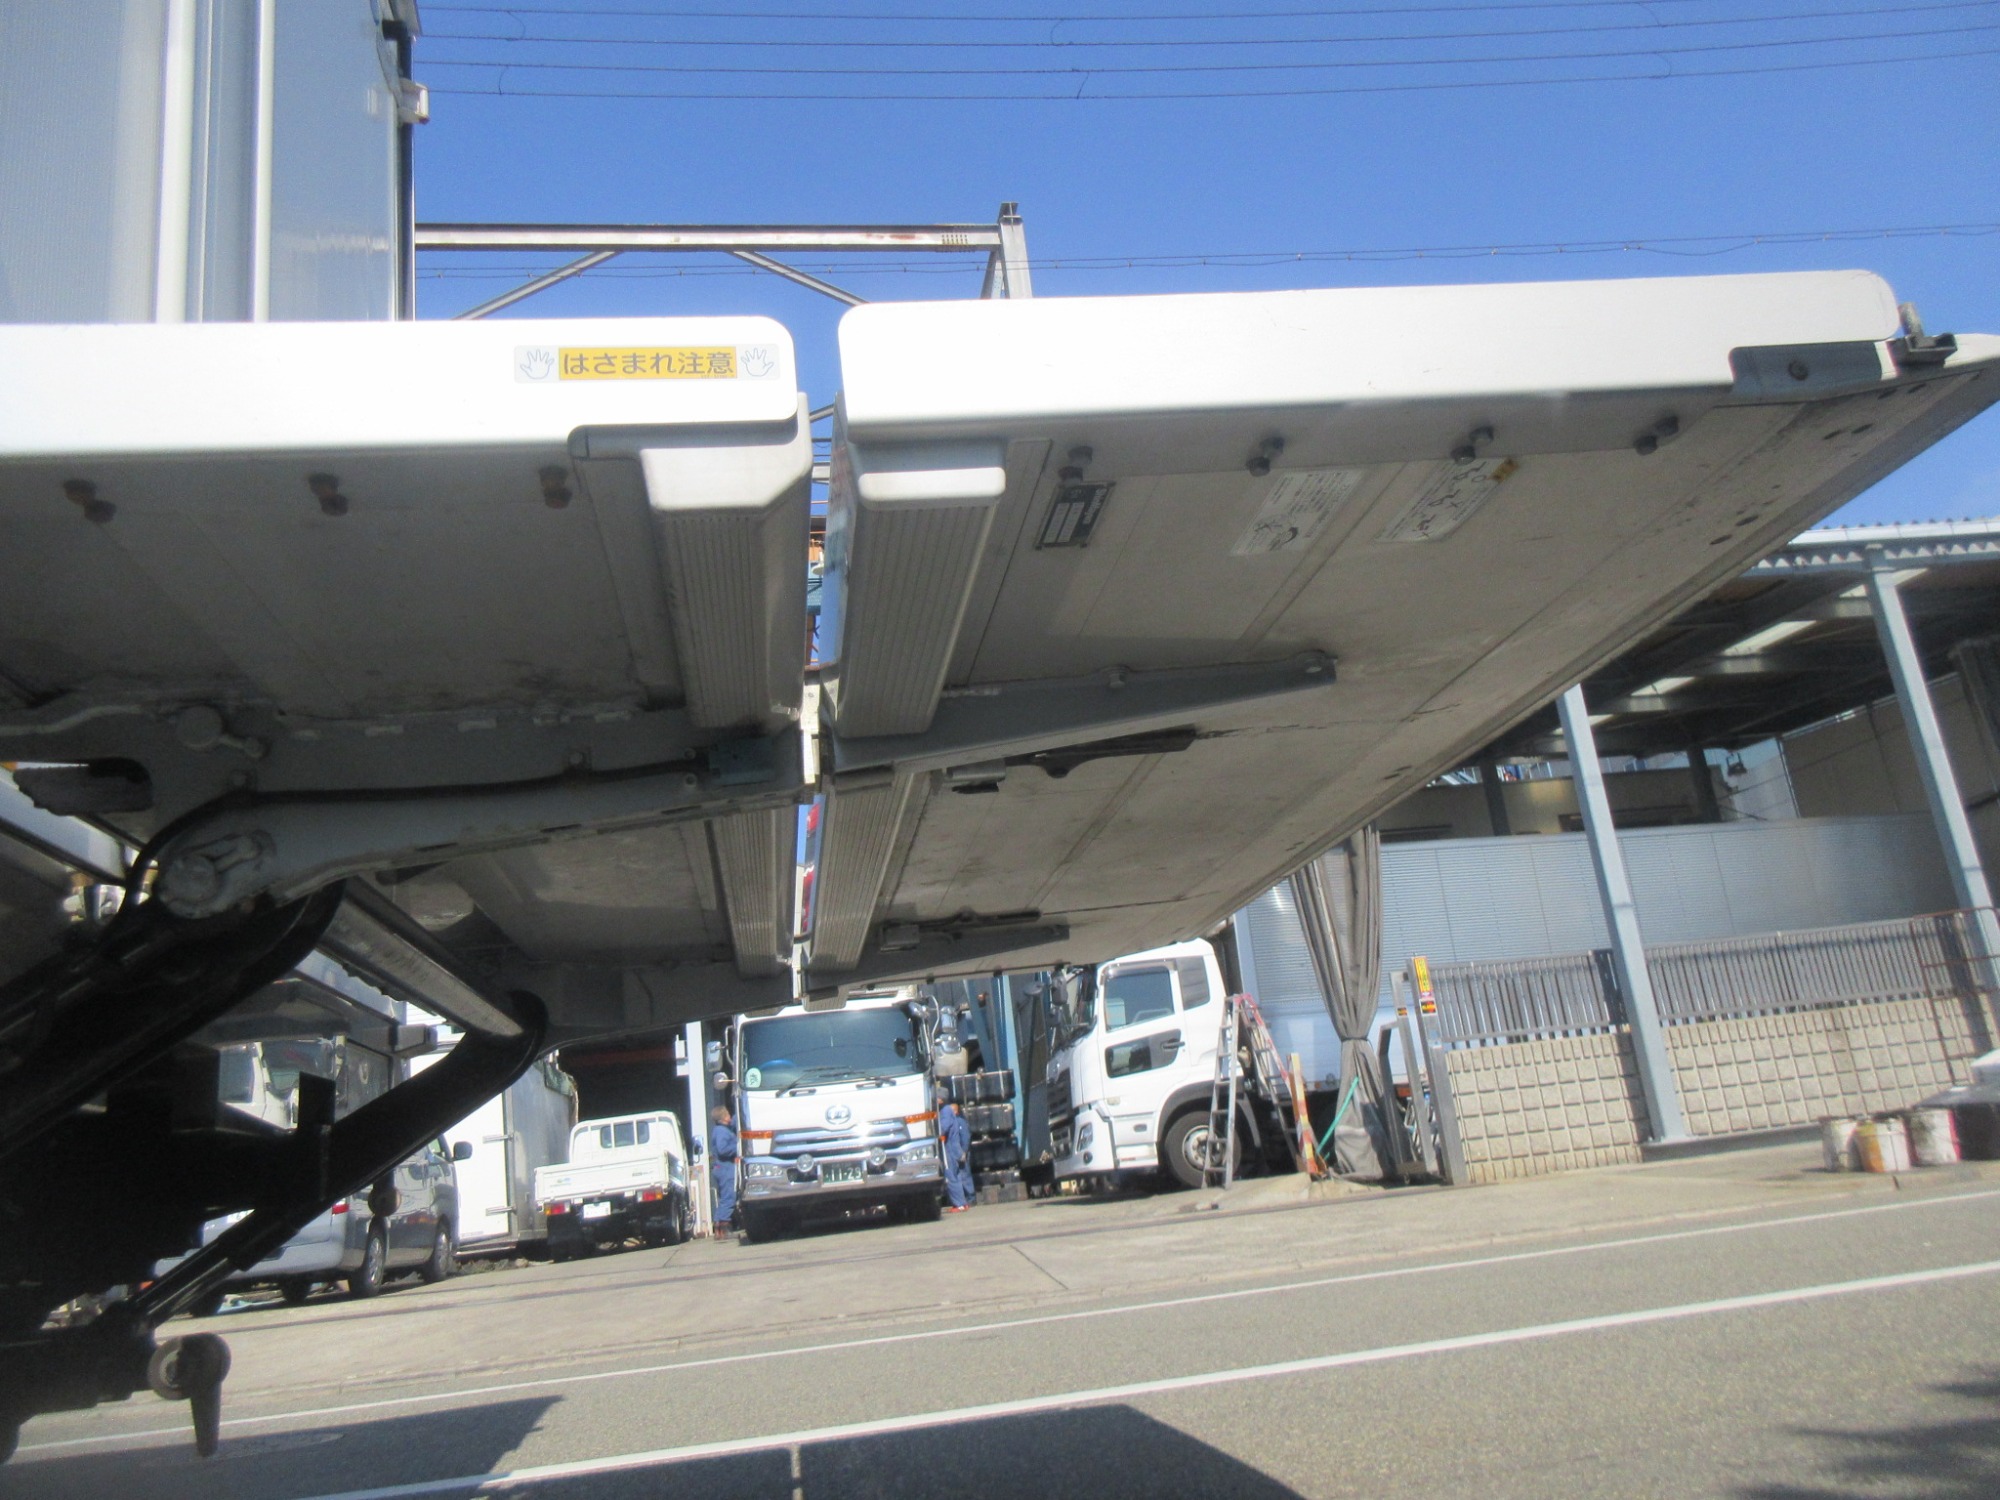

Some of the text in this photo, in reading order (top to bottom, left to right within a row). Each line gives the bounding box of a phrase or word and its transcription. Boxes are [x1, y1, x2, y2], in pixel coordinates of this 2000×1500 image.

[563, 350, 734, 376] はさまれ注意
